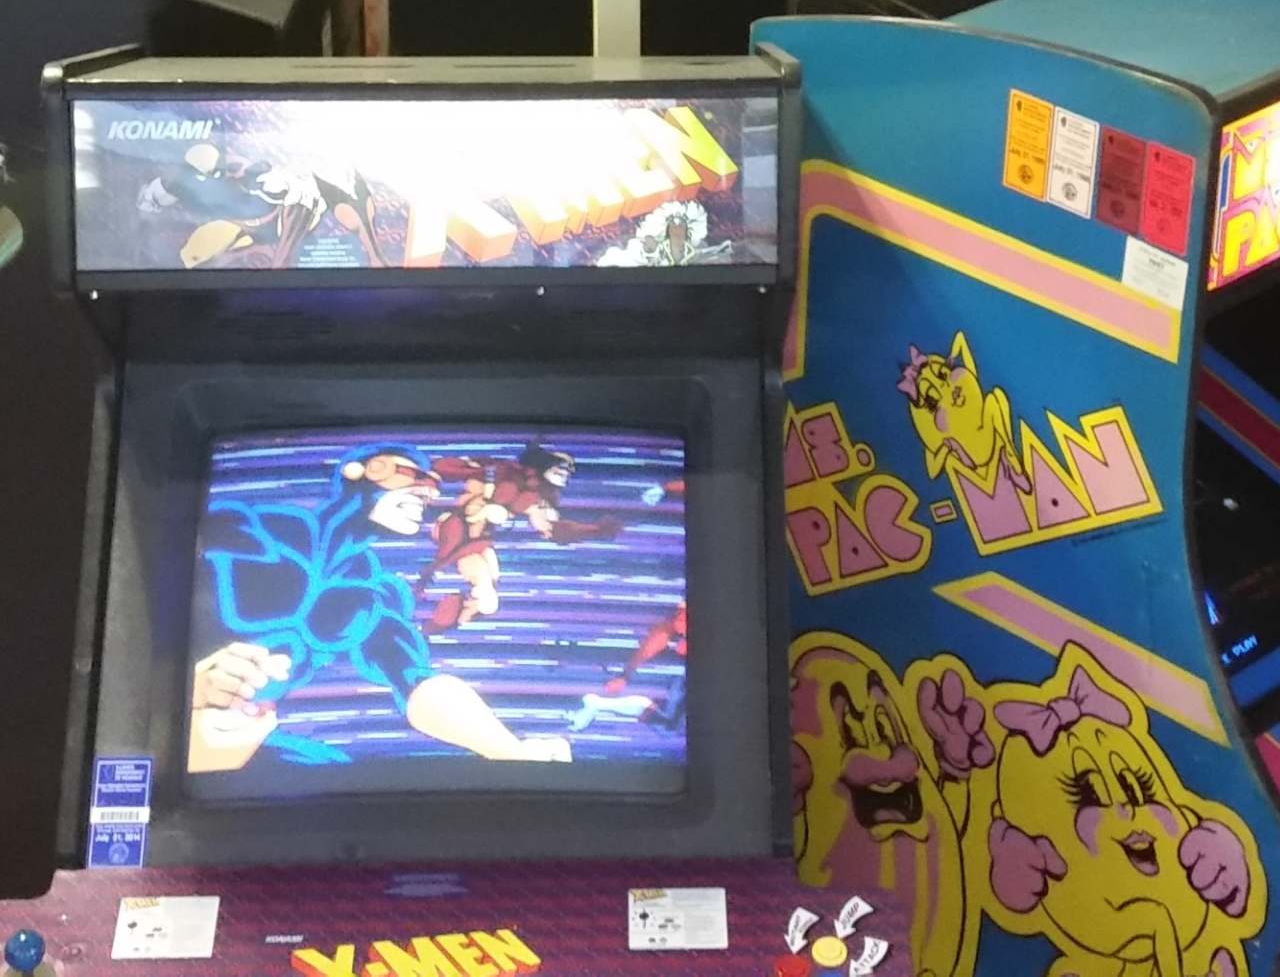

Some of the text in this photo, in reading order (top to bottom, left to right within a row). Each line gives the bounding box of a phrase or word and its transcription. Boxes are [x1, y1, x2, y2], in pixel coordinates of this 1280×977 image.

[108, 120, 214, 140] KONAMI
[784, 420, 1152, 589] PAC-MAN
[290, 928, 542, 977] X-MEN
